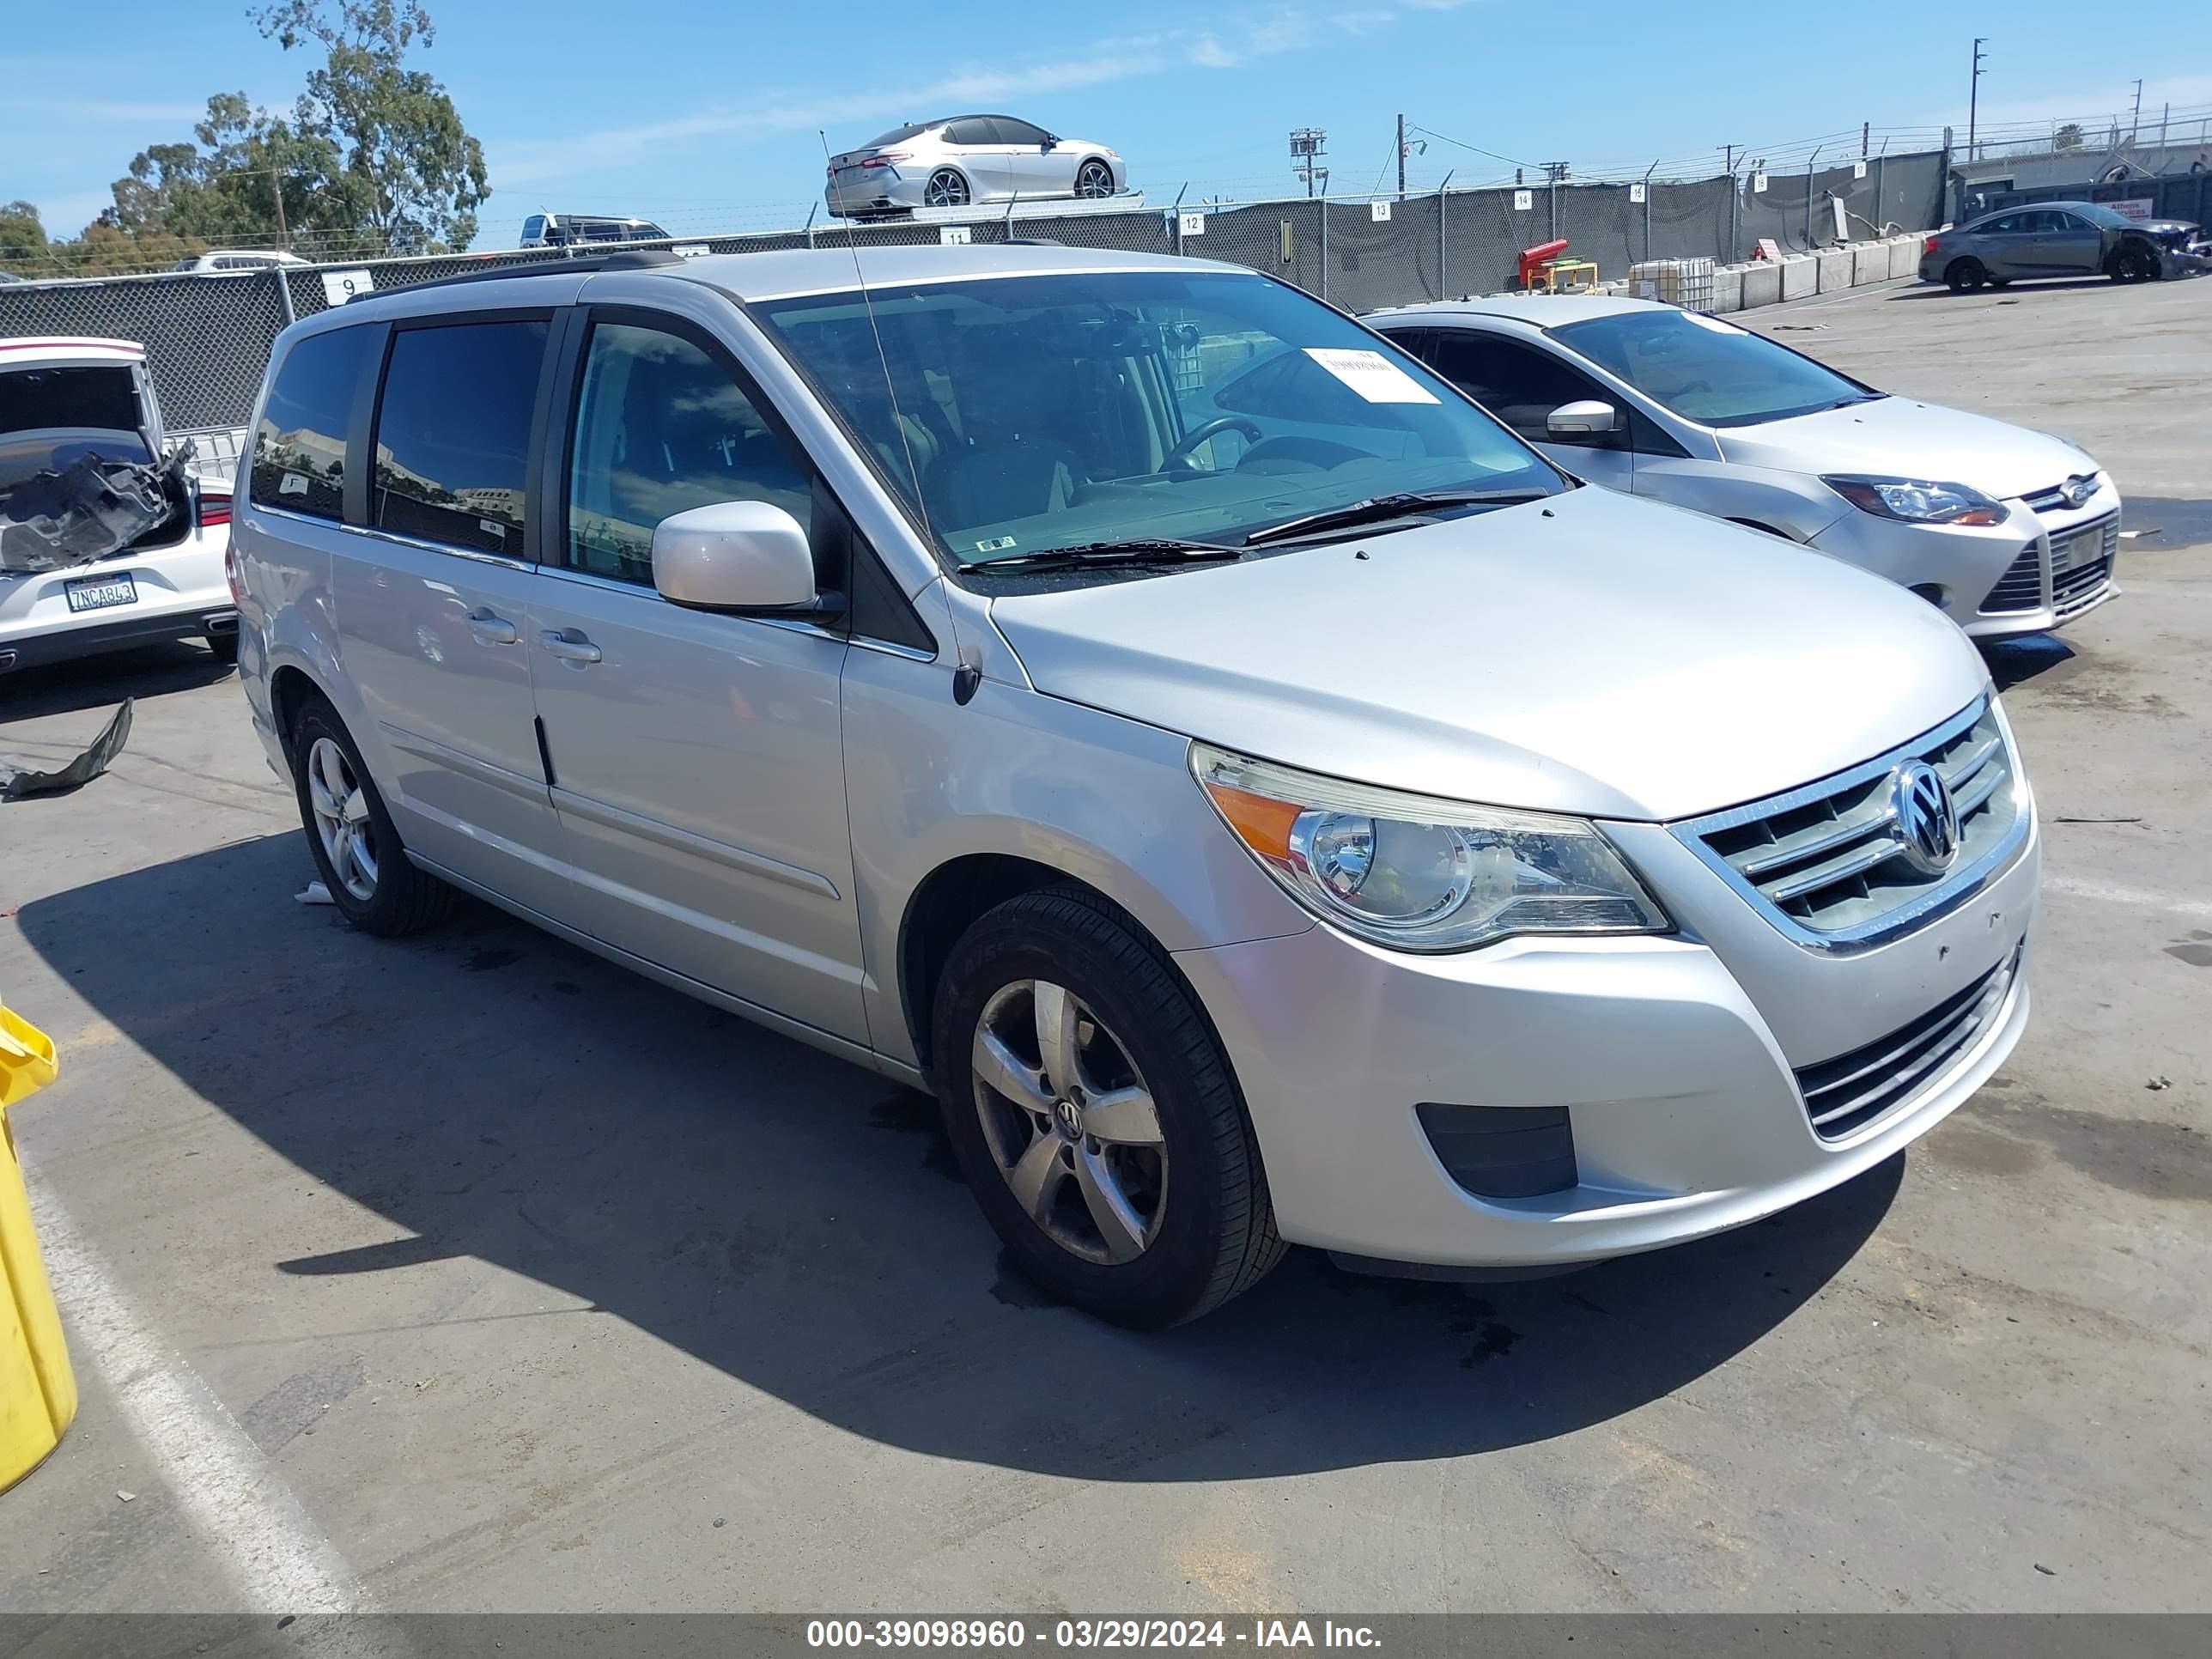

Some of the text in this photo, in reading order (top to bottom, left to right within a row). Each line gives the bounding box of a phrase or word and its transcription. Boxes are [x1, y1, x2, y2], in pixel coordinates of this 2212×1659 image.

[1376, 205, 1386, 216] 13
[1187, 217, 1198, 229] 12
[343, 279, 356, 295] 9
[71, 585, 132, 607] 7NCA843
